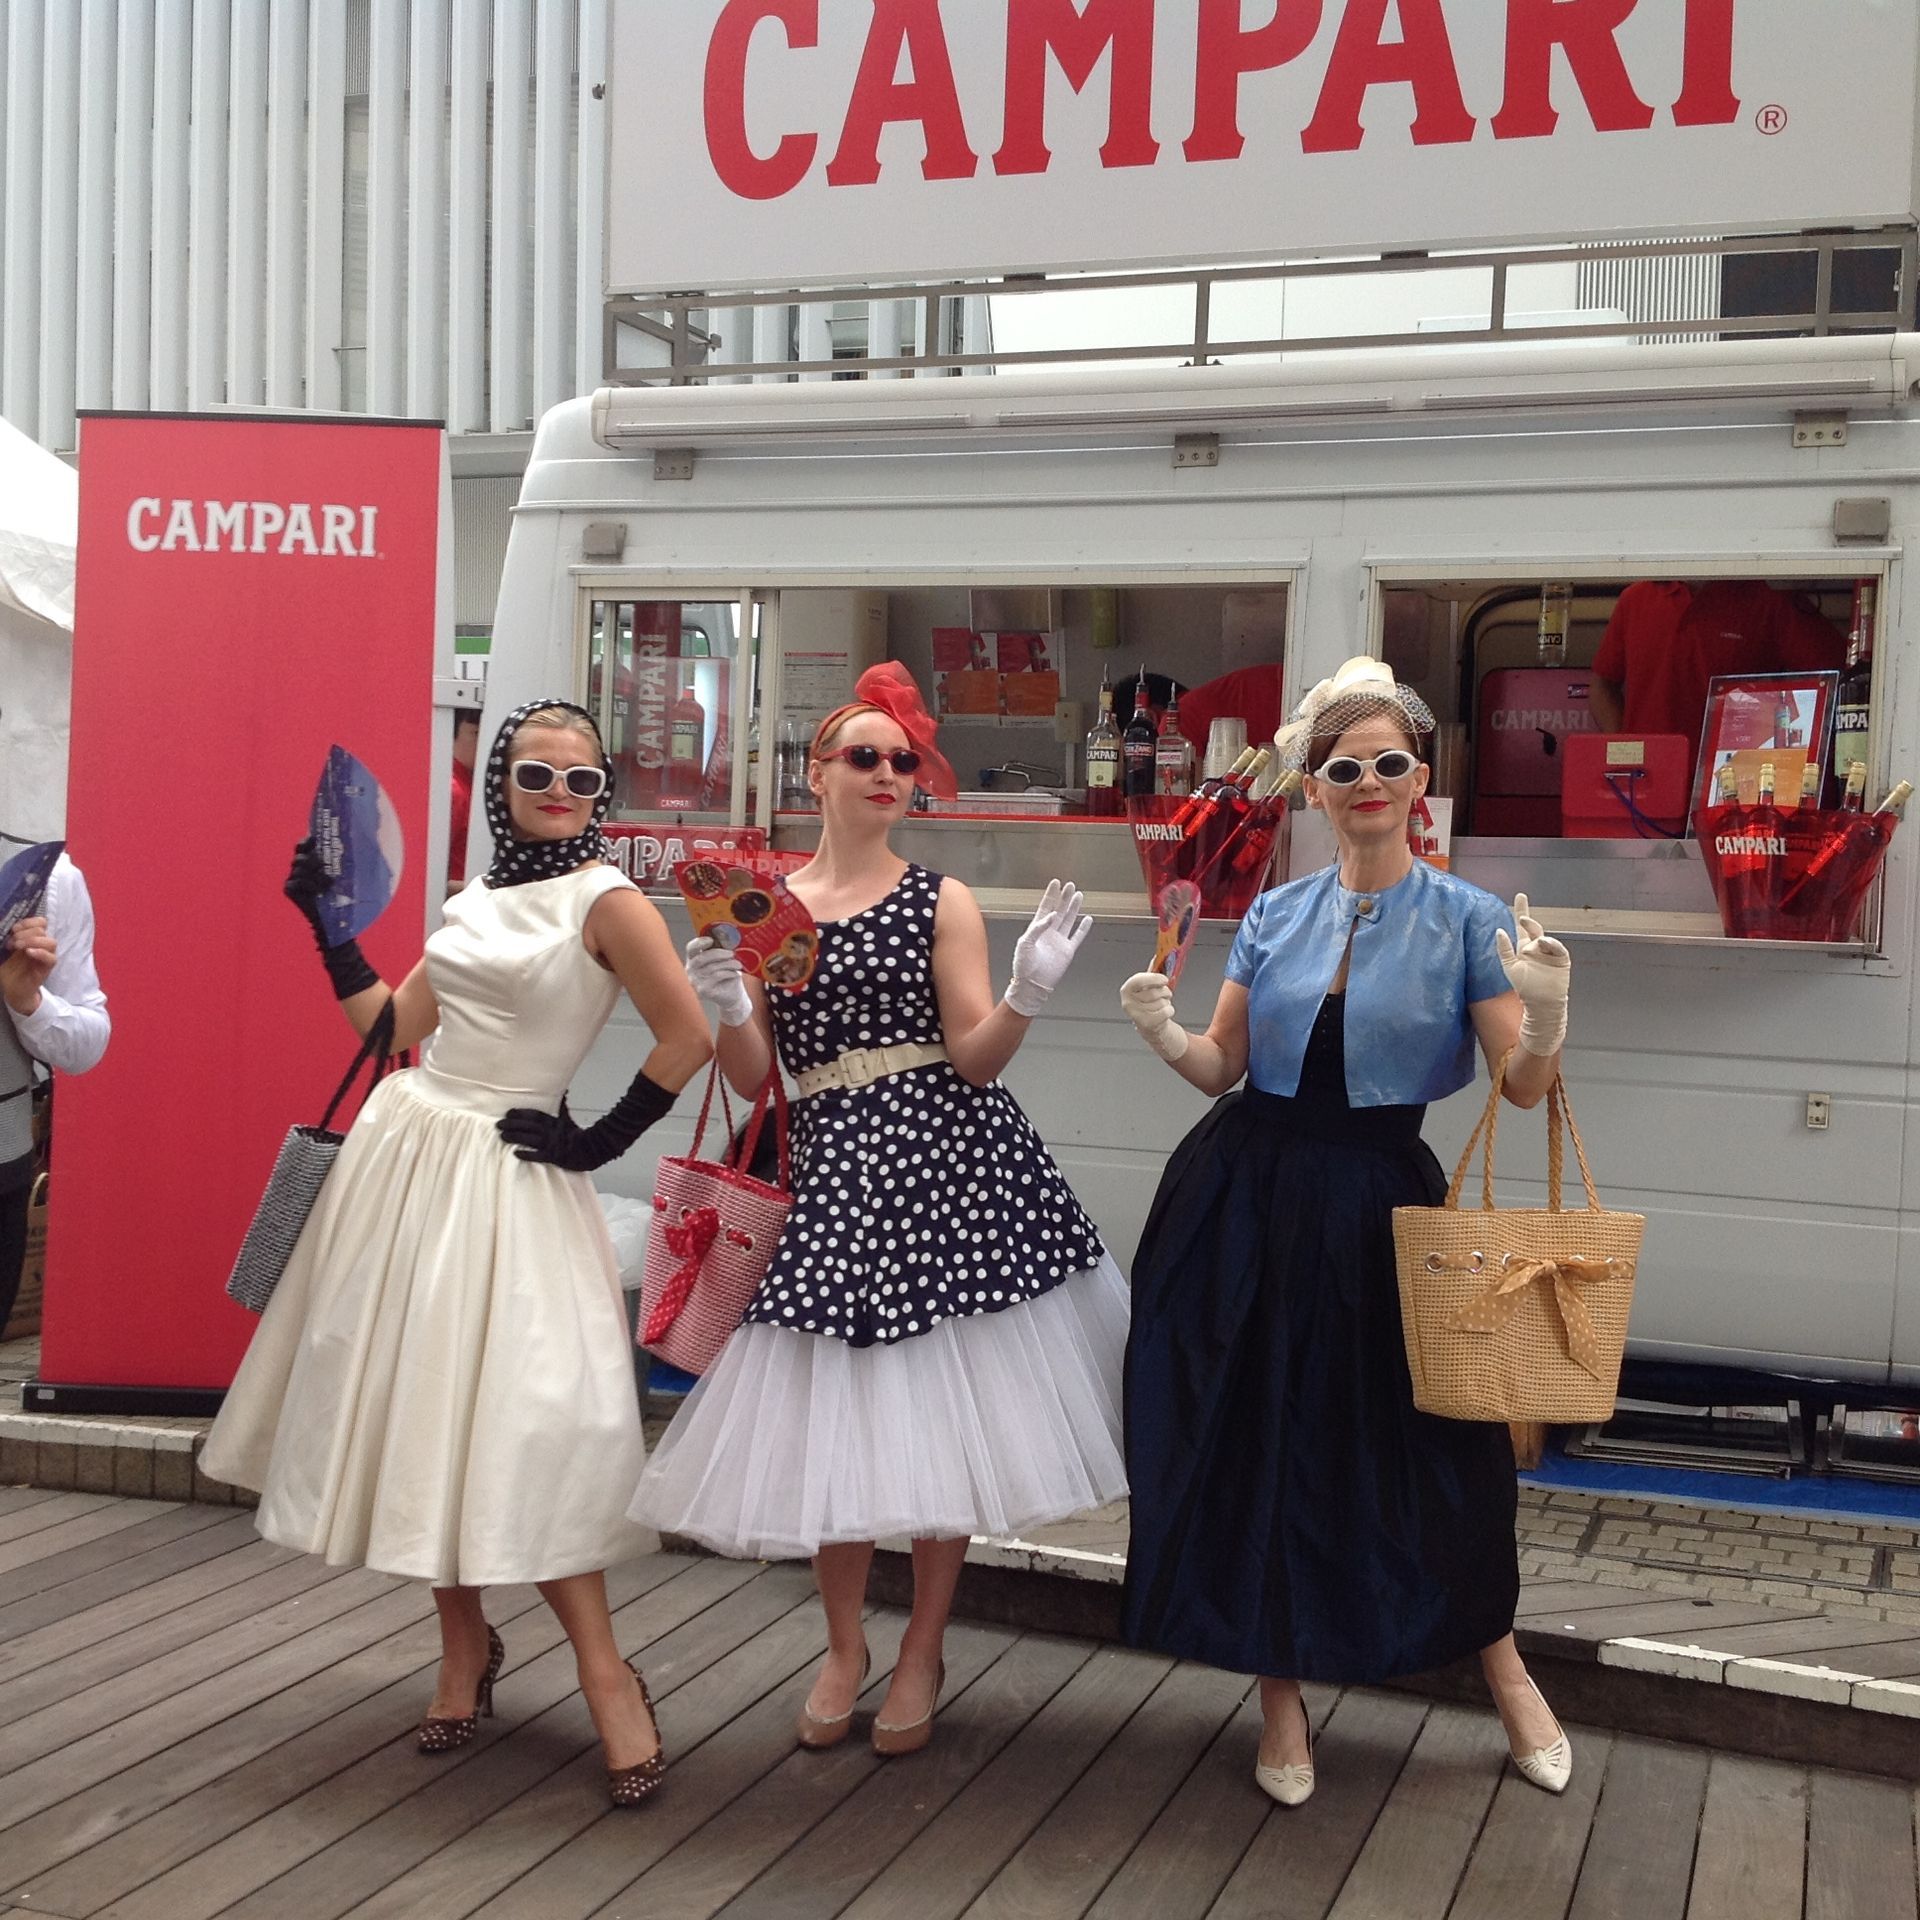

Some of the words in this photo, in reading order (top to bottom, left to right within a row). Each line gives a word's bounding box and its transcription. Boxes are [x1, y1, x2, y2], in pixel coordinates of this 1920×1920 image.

[703, 0, 1741, 200] CAMPARI
[127, 496, 379, 557] CAMPARI
[637, 634, 667, 769] CAMPARI
[1491, 709, 1590, 731] CAMPARI
[1086, 750, 1118, 760] CAMPARI
[1135, 823, 1185, 841] CAMPARI
[1715, 836, 1787, 856] CAMPARI
